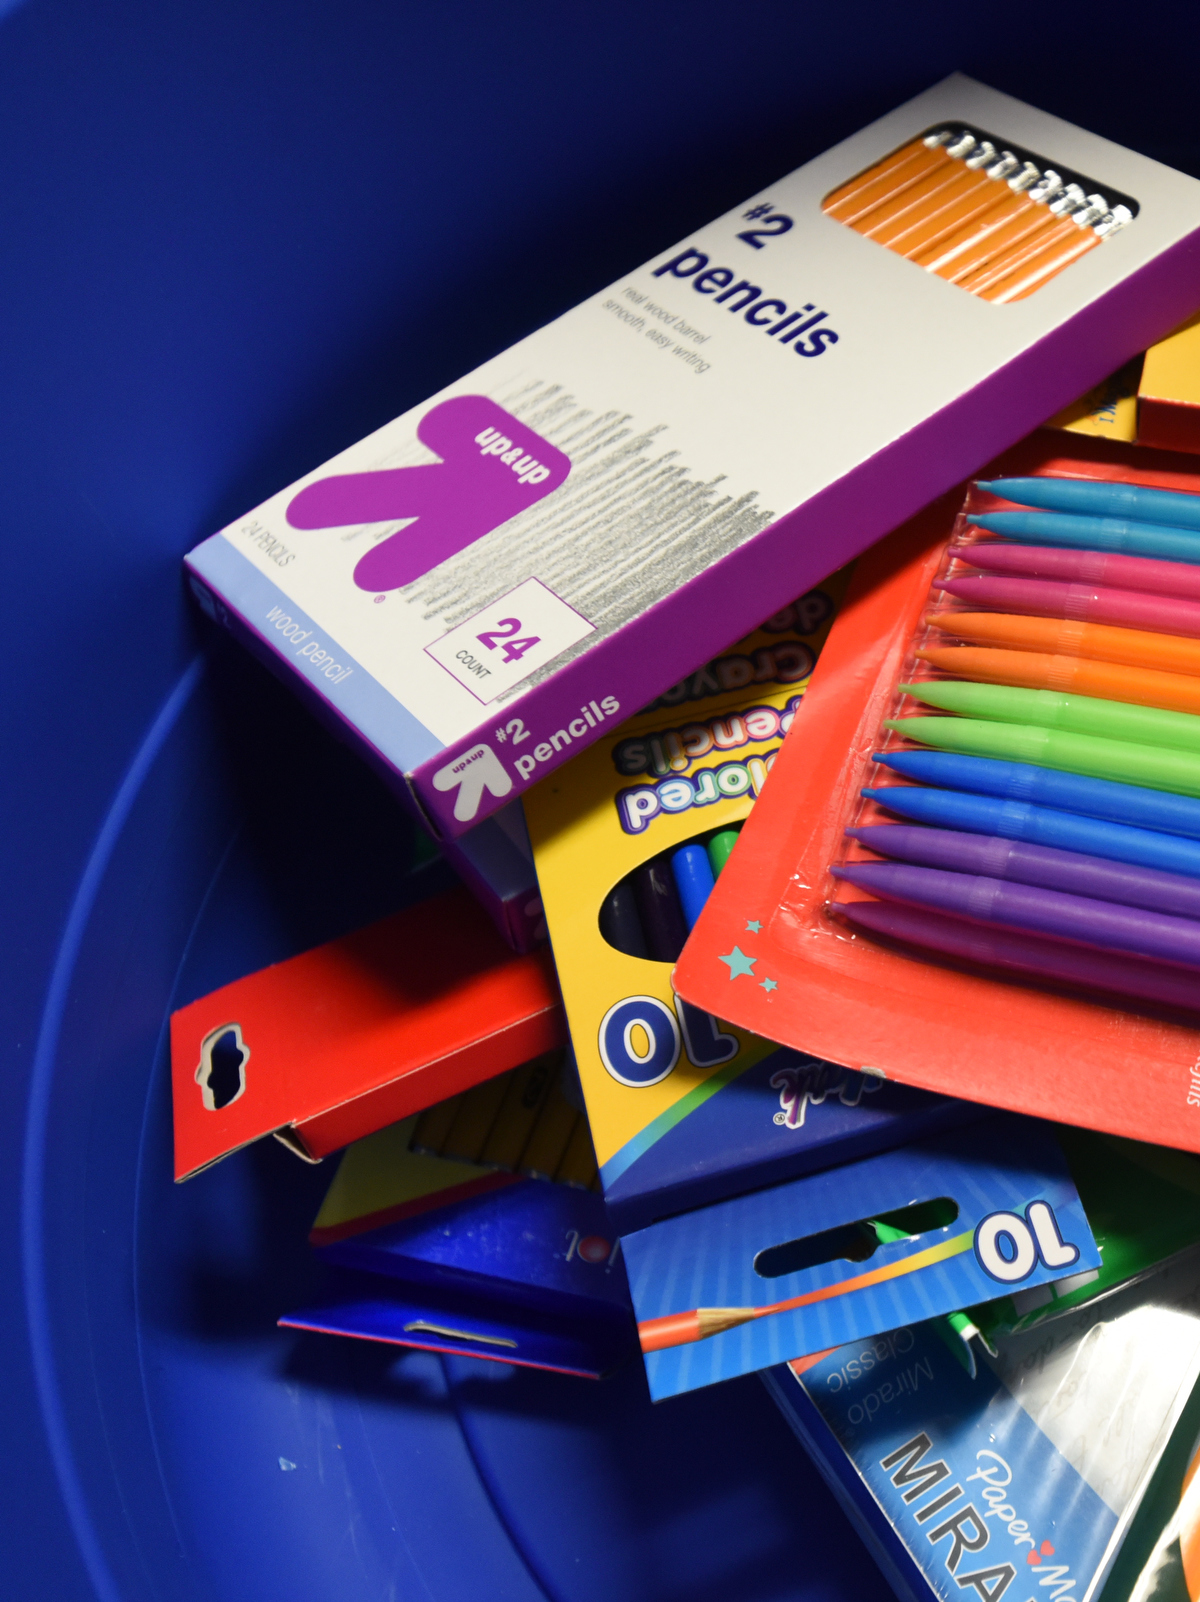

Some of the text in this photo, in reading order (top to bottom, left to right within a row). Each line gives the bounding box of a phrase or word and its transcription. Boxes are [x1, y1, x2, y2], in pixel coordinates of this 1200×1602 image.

[735, 202, 794, 250] #2
[621, 286, 711, 345] real wood barrel
[650, 246, 839, 358] pencils
[602, 299, 711, 375] smooth, easy writing
[474, 426, 551, 485] up&up
[241, 520, 296, 568] 24 PENCILS
[264, 605, 312, 646] wood
[299, 640, 354, 685] pencil
[455, 649, 492, 681] COUNT
[475, 617, 542, 665] 24
[451, 748, 486, 774] up&up
[494, 716, 531, 747] #2
[513, 692, 621, 781] pencils
[598, 993, 739, 1089] 10
[973, 1199, 1080, 1285] 10
[826, 1327, 915, 1393] Classic
[848, 1356, 934, 1424] Mirado
[879, 1431, 1037, 1602] MIRA
[966, 1449, 1036, 1549] Paper
